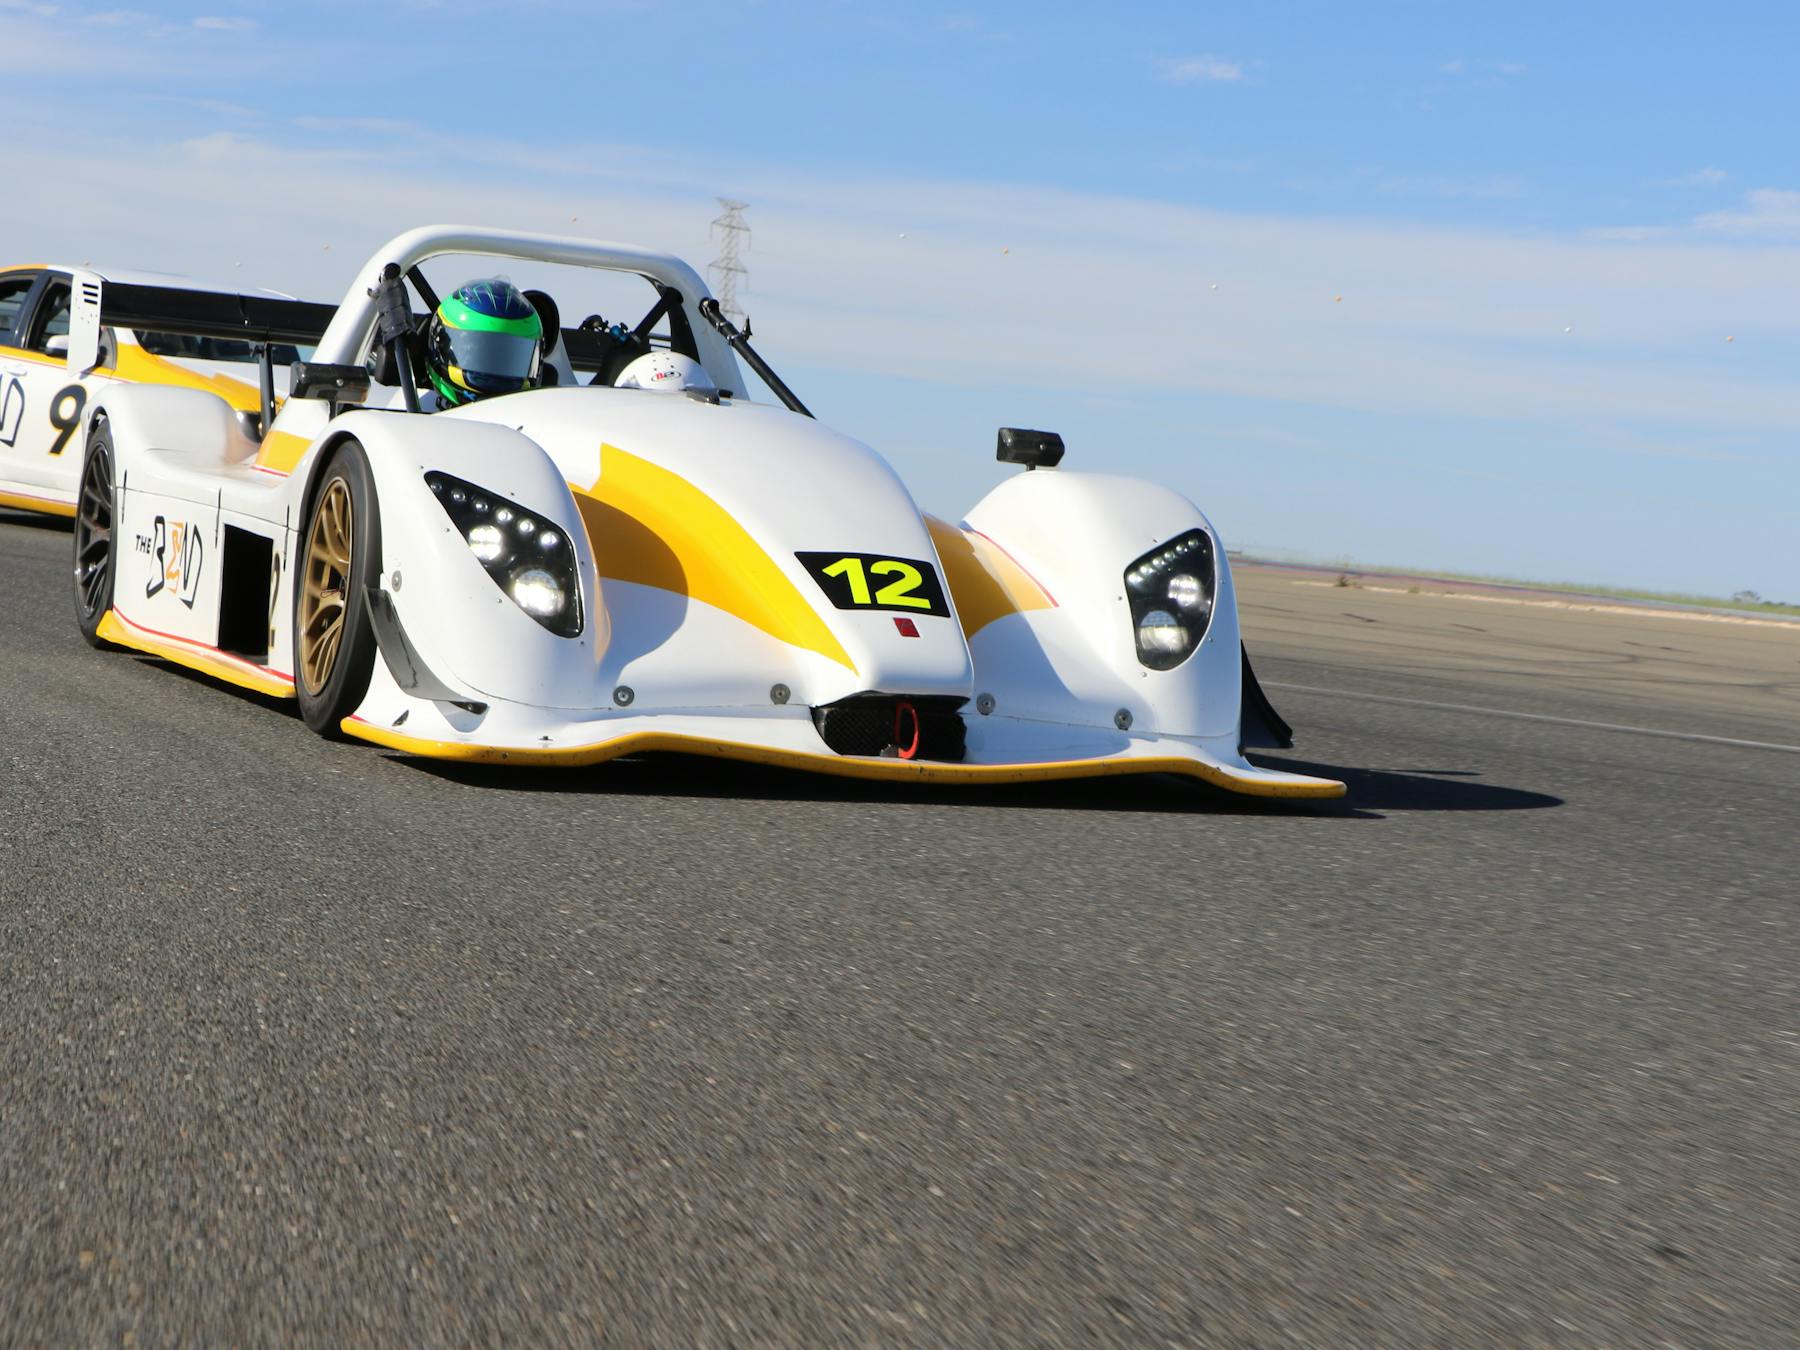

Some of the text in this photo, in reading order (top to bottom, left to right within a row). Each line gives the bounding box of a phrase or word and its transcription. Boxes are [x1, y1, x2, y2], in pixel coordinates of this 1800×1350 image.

[48, 384, 87, 455] 9
[135, 534, 151, 554] THE
[822, 557, 931, 609] 12
